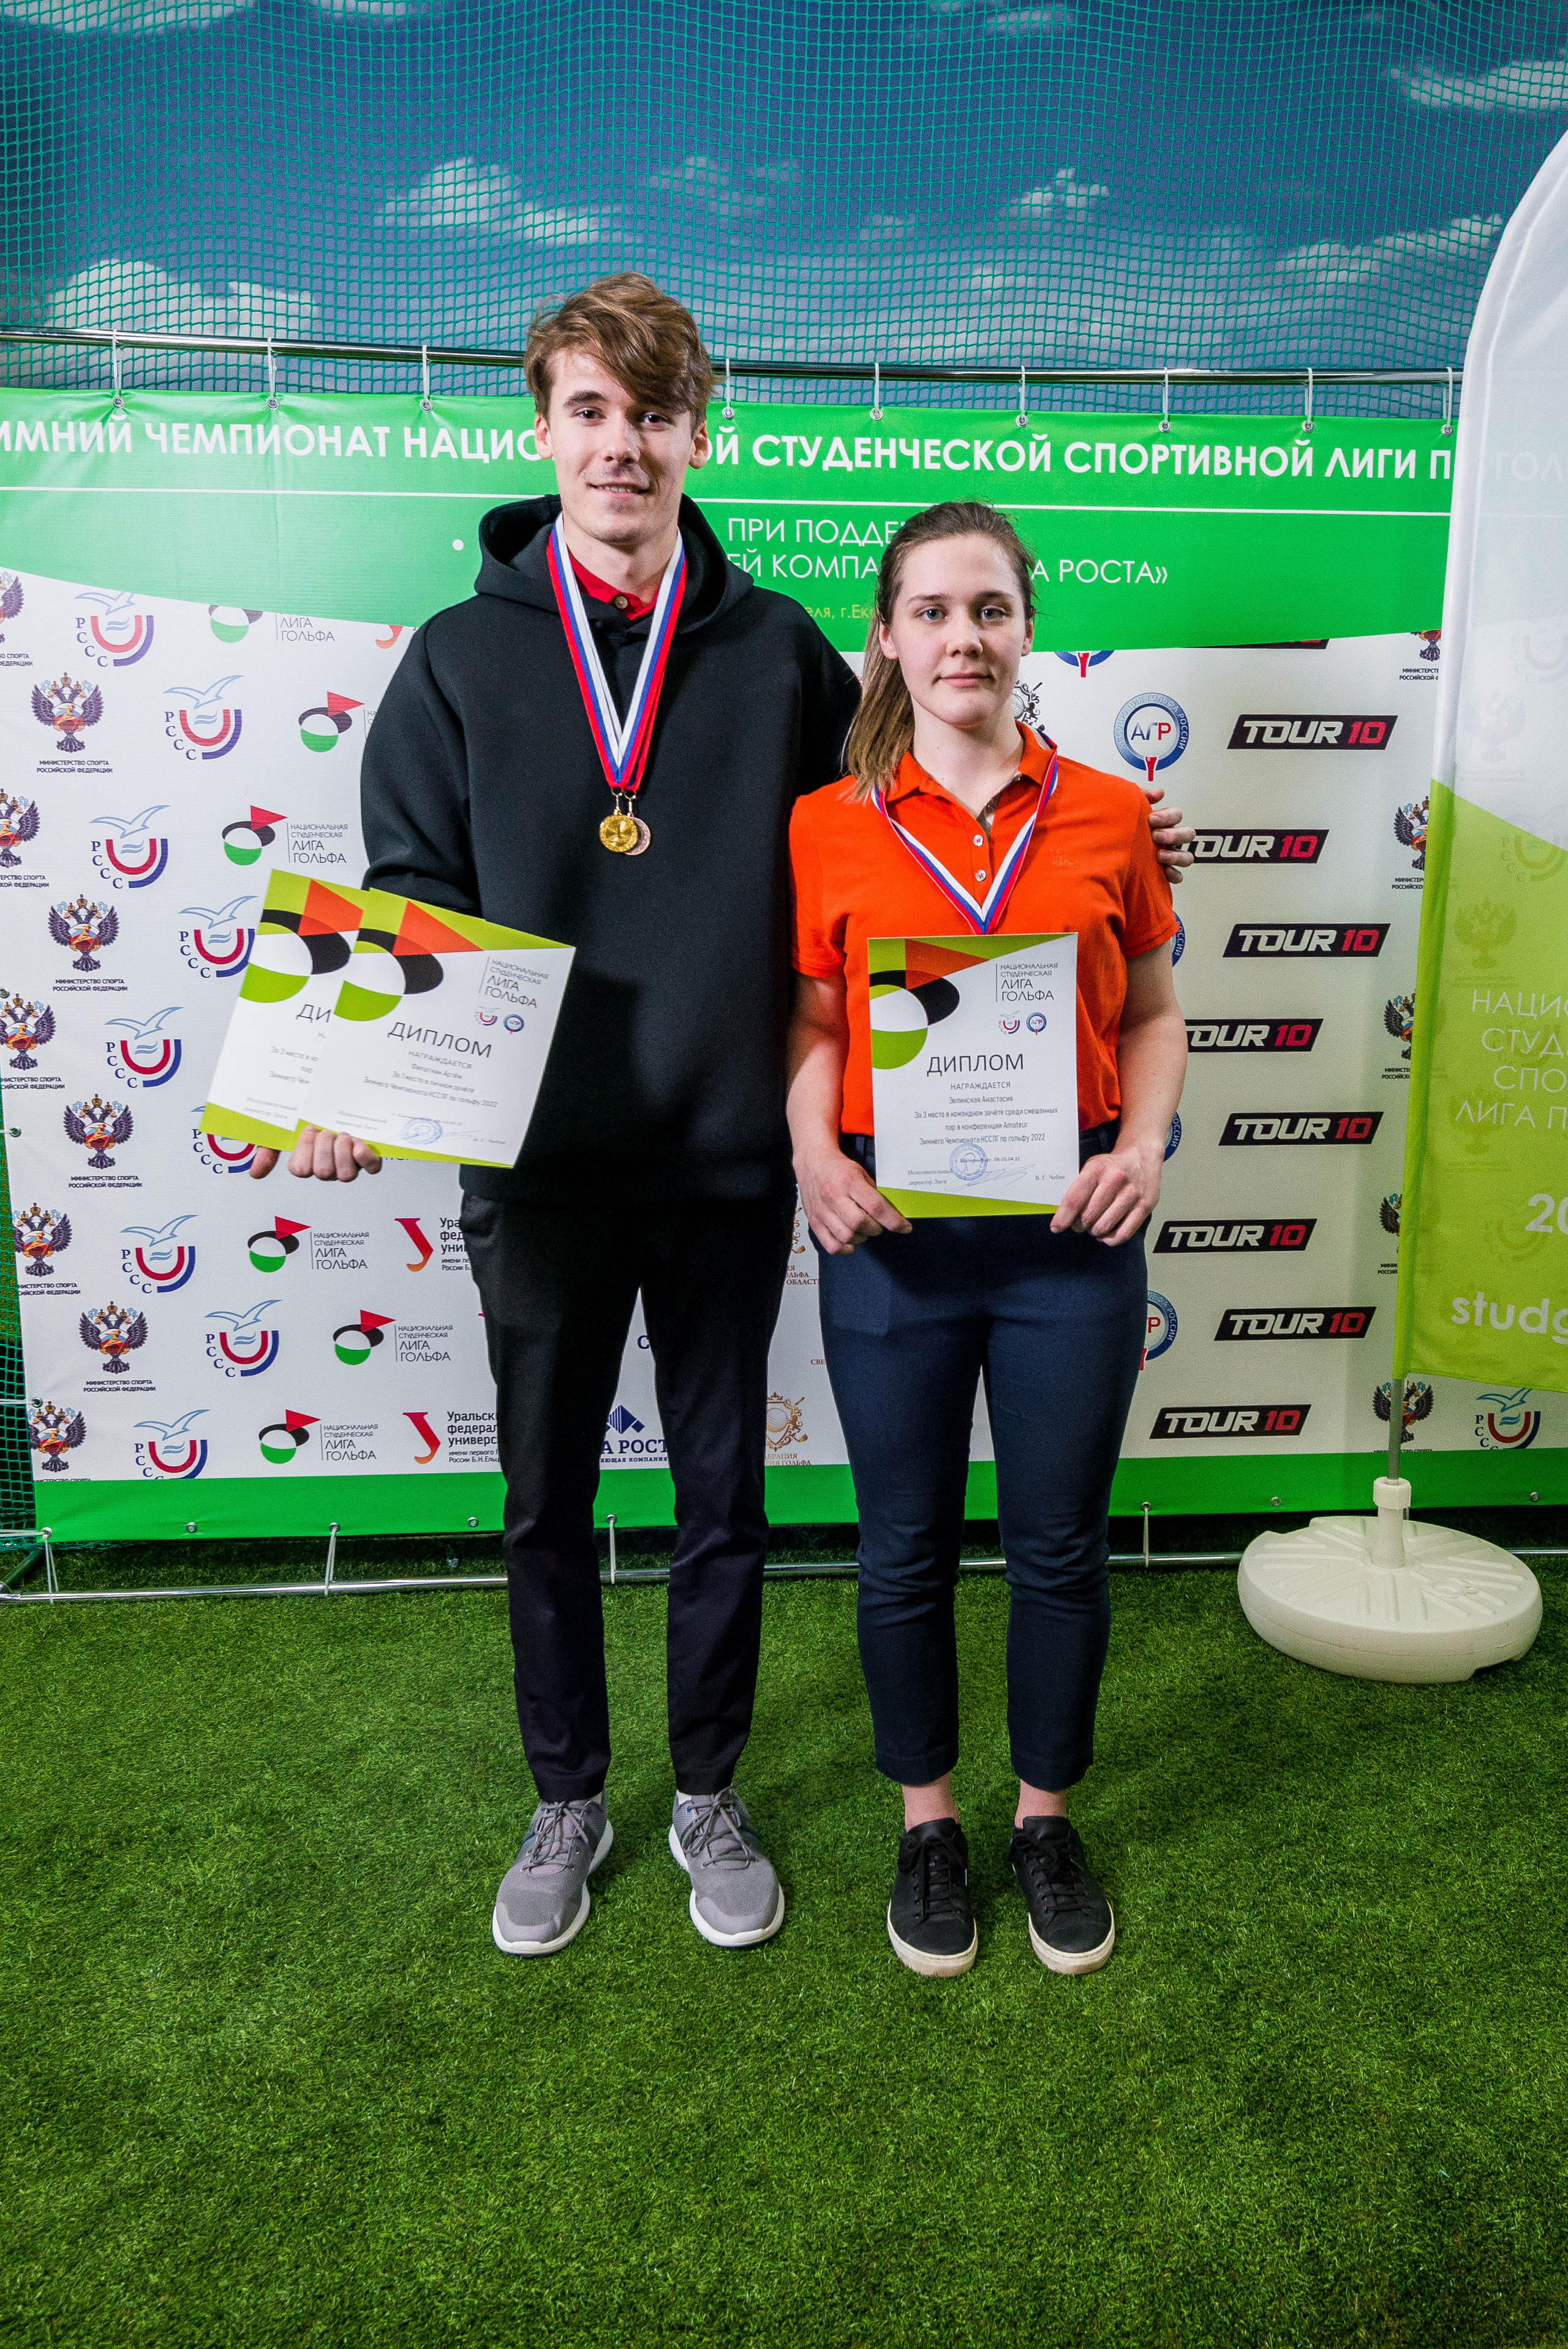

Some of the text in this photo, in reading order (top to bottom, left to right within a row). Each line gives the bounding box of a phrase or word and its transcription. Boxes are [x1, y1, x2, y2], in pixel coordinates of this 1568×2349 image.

[145, 422, 391, 458] ЧЕМПИОНАТ
[752, 433, 1051, 473] СТУДЕНЧЕСКОЙ
[1064, 439, 1313, 477] СПОРТИВНОЙ
[1324, 448, 1416, 479] ЛИГИ
[729, 518, 905, 547] ПРИ ПОДДЕ
[1060, 559, 1168, 584] РОСТА»
[280, 617, 313, 628] ЛИГА
[282, 630, 335, 641] ГОЛЬФА
[1177, 713, 1188, 749] РОССИИ
[1242, 720, 1387, 744] TOUR 10
[292, 840, 325, 851] ЛИГА
[1181, 835, 1319, 858] OUR 10
[293, 852, 347, 864] ГОЛЬФА
[1238, 929, 1379, 951] TOUR 10
[487, 975, 519, 992] ЛИГА
[1001, 978, 1033, 989] ЛИГА
[484, 986, 538, 1008] ГОЛЬФА
[1001, 990, 1055, 1001] ГОЛЬФА
[387, 1022, 492, 1058] ДИПЛОМ
[1274, 1025, 1313, 1046] 10
[927, 1054, 1023, 1077] ДИПЛОМ
[950, 1081, 1011, 1090] НАГРАЖДАЕТСЯ
[1455, 1100, 1536, 1128] ЛИГА
[1234, 1117, 1373, 1140] TOUR 10
[1168, 1224, 1306, 1248] TOUR 10
[315, 1248, 347, 1257] ЛИГА
[316, 1259, 368, 1270] ГОЛЬФА
[1167, 1308, 1177, 1341] РОССИИ
[1229, 1312, 1366, 1335] TOUR 10
[399, 1340, 431, 1350] ЛИГА
[400, 1351, 451, 1362] ГОЛЬФА
[447, 1411, 497, 1423] Уральск
[1164, 1409, 1301, 1433] TOUR 10
[448, 1436, 497, 1448] универс
[1474, 1414, 1499, 1449] РСС
[325, 1439, 356, 1449] ЛИГА
[134, 1443, 164, 1480] РСС
[326, 1450, 377, 1461] ГОЛЬФА
